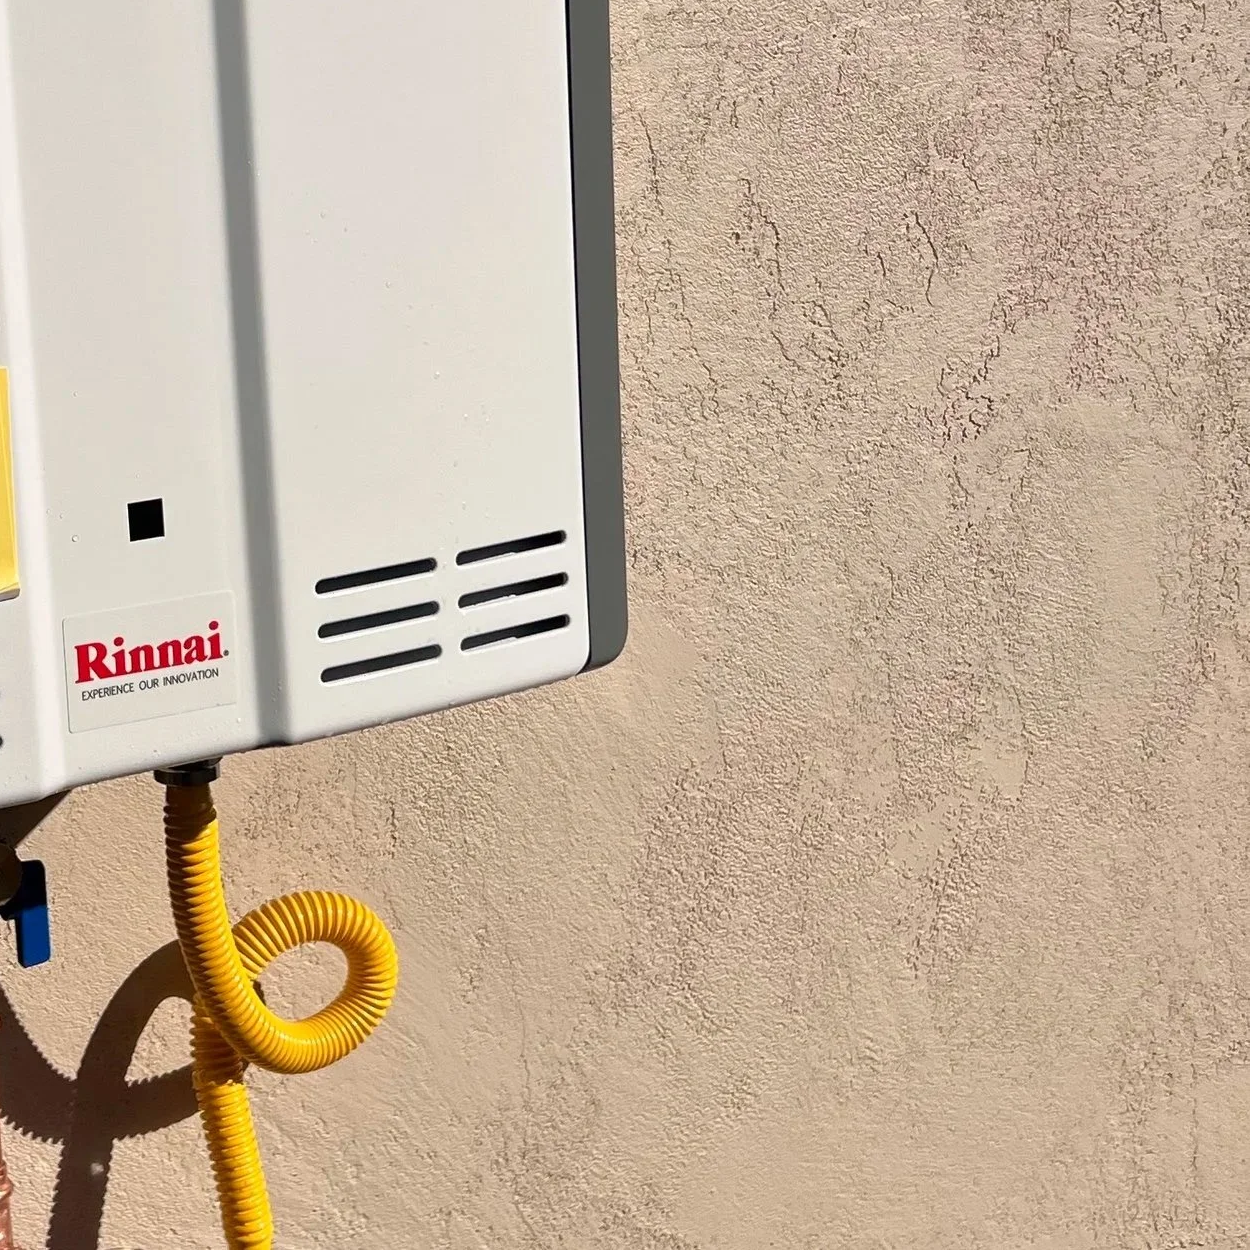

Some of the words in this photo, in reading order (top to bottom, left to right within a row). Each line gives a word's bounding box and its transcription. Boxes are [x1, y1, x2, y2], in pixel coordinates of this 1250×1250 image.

[74, 620, 224, 684] Rinnai
[81, 682, 135, 701] EXPERIENCE
[138, 678, 160, 691] OUR
[163, 667, 220, 686] INNOVATION
